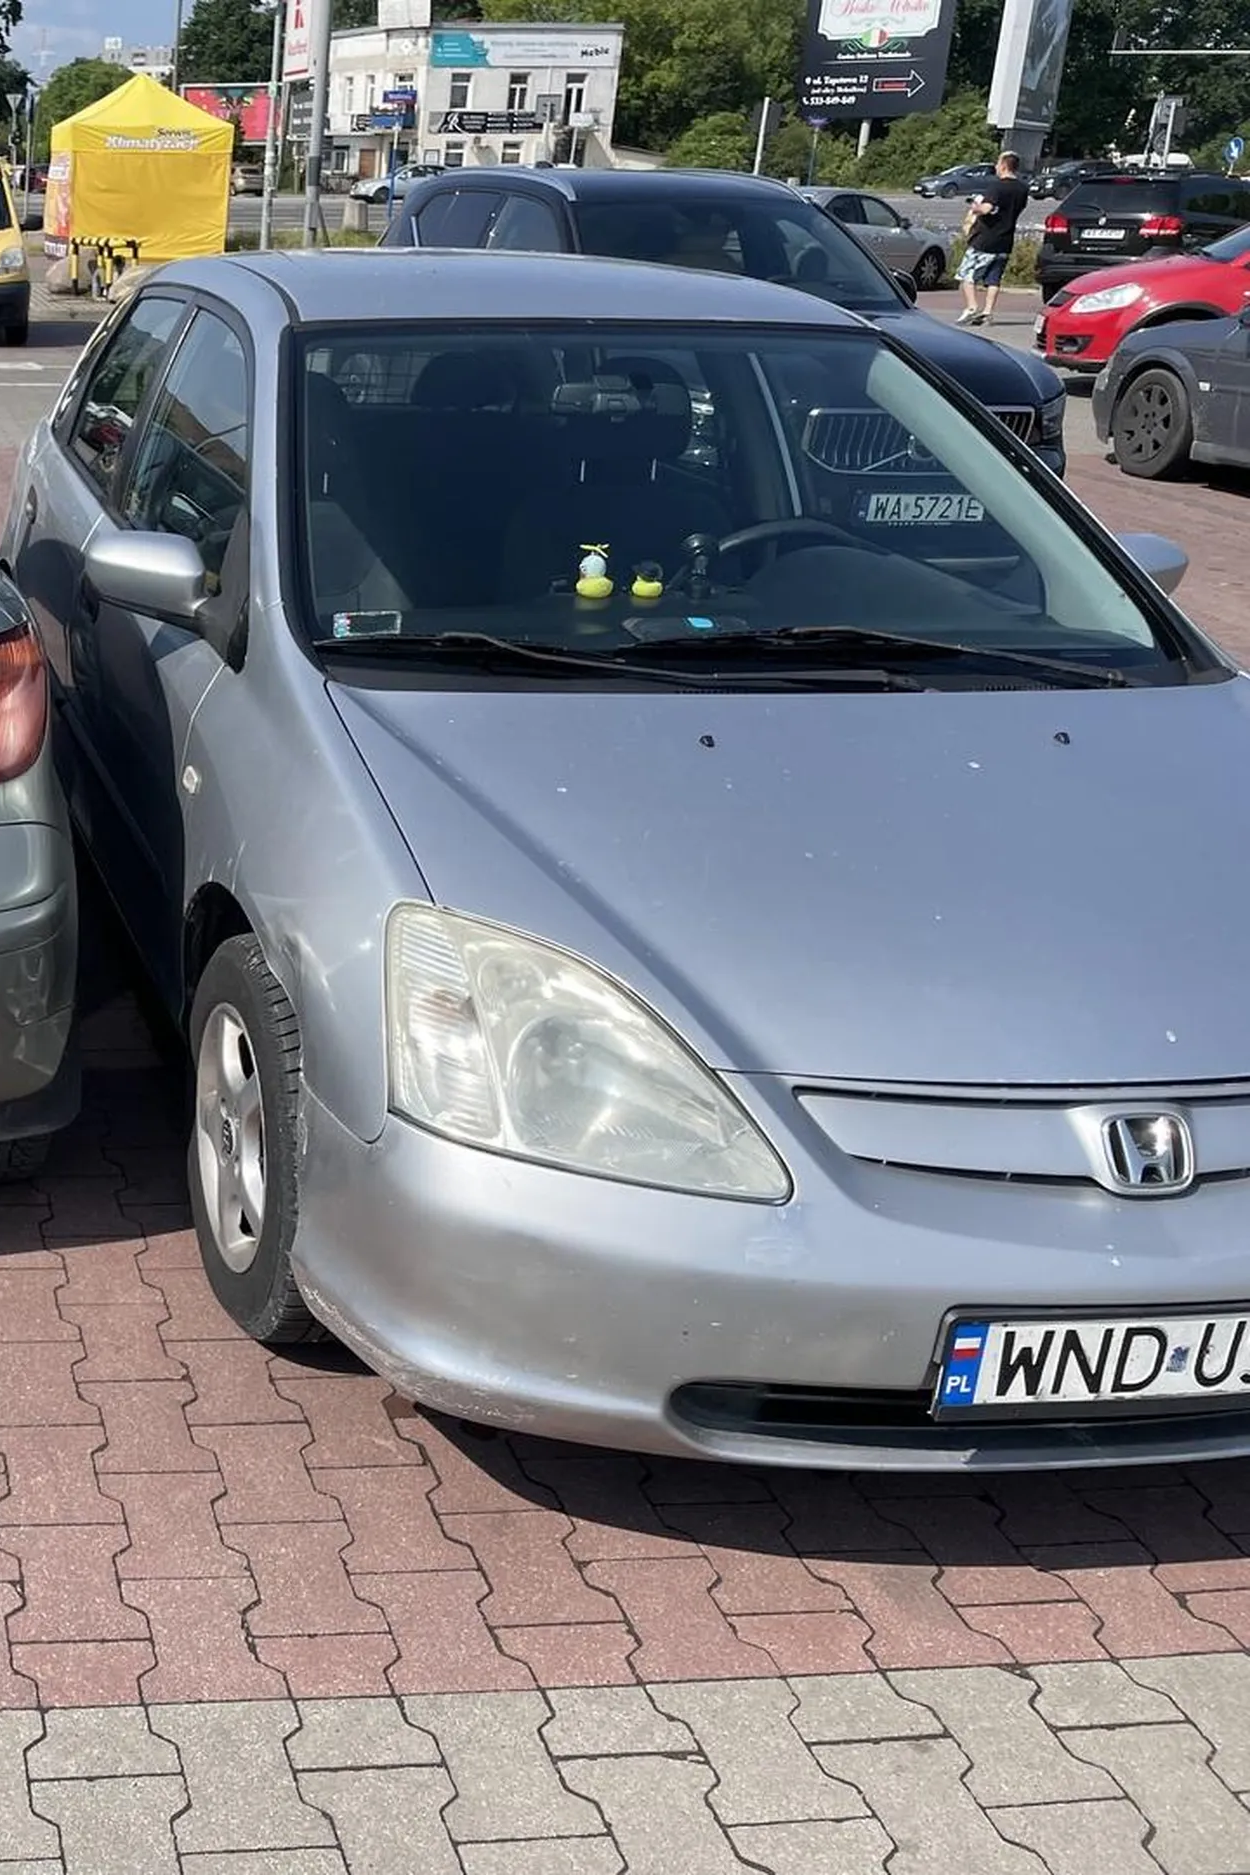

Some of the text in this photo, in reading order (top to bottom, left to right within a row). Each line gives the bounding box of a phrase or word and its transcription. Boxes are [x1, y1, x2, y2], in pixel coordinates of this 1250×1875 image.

[873, 496, 980, 519] WA 5721E
[994, 1319, 1250, 1398] WND U
[944, 1375, 972, 1394] PL
